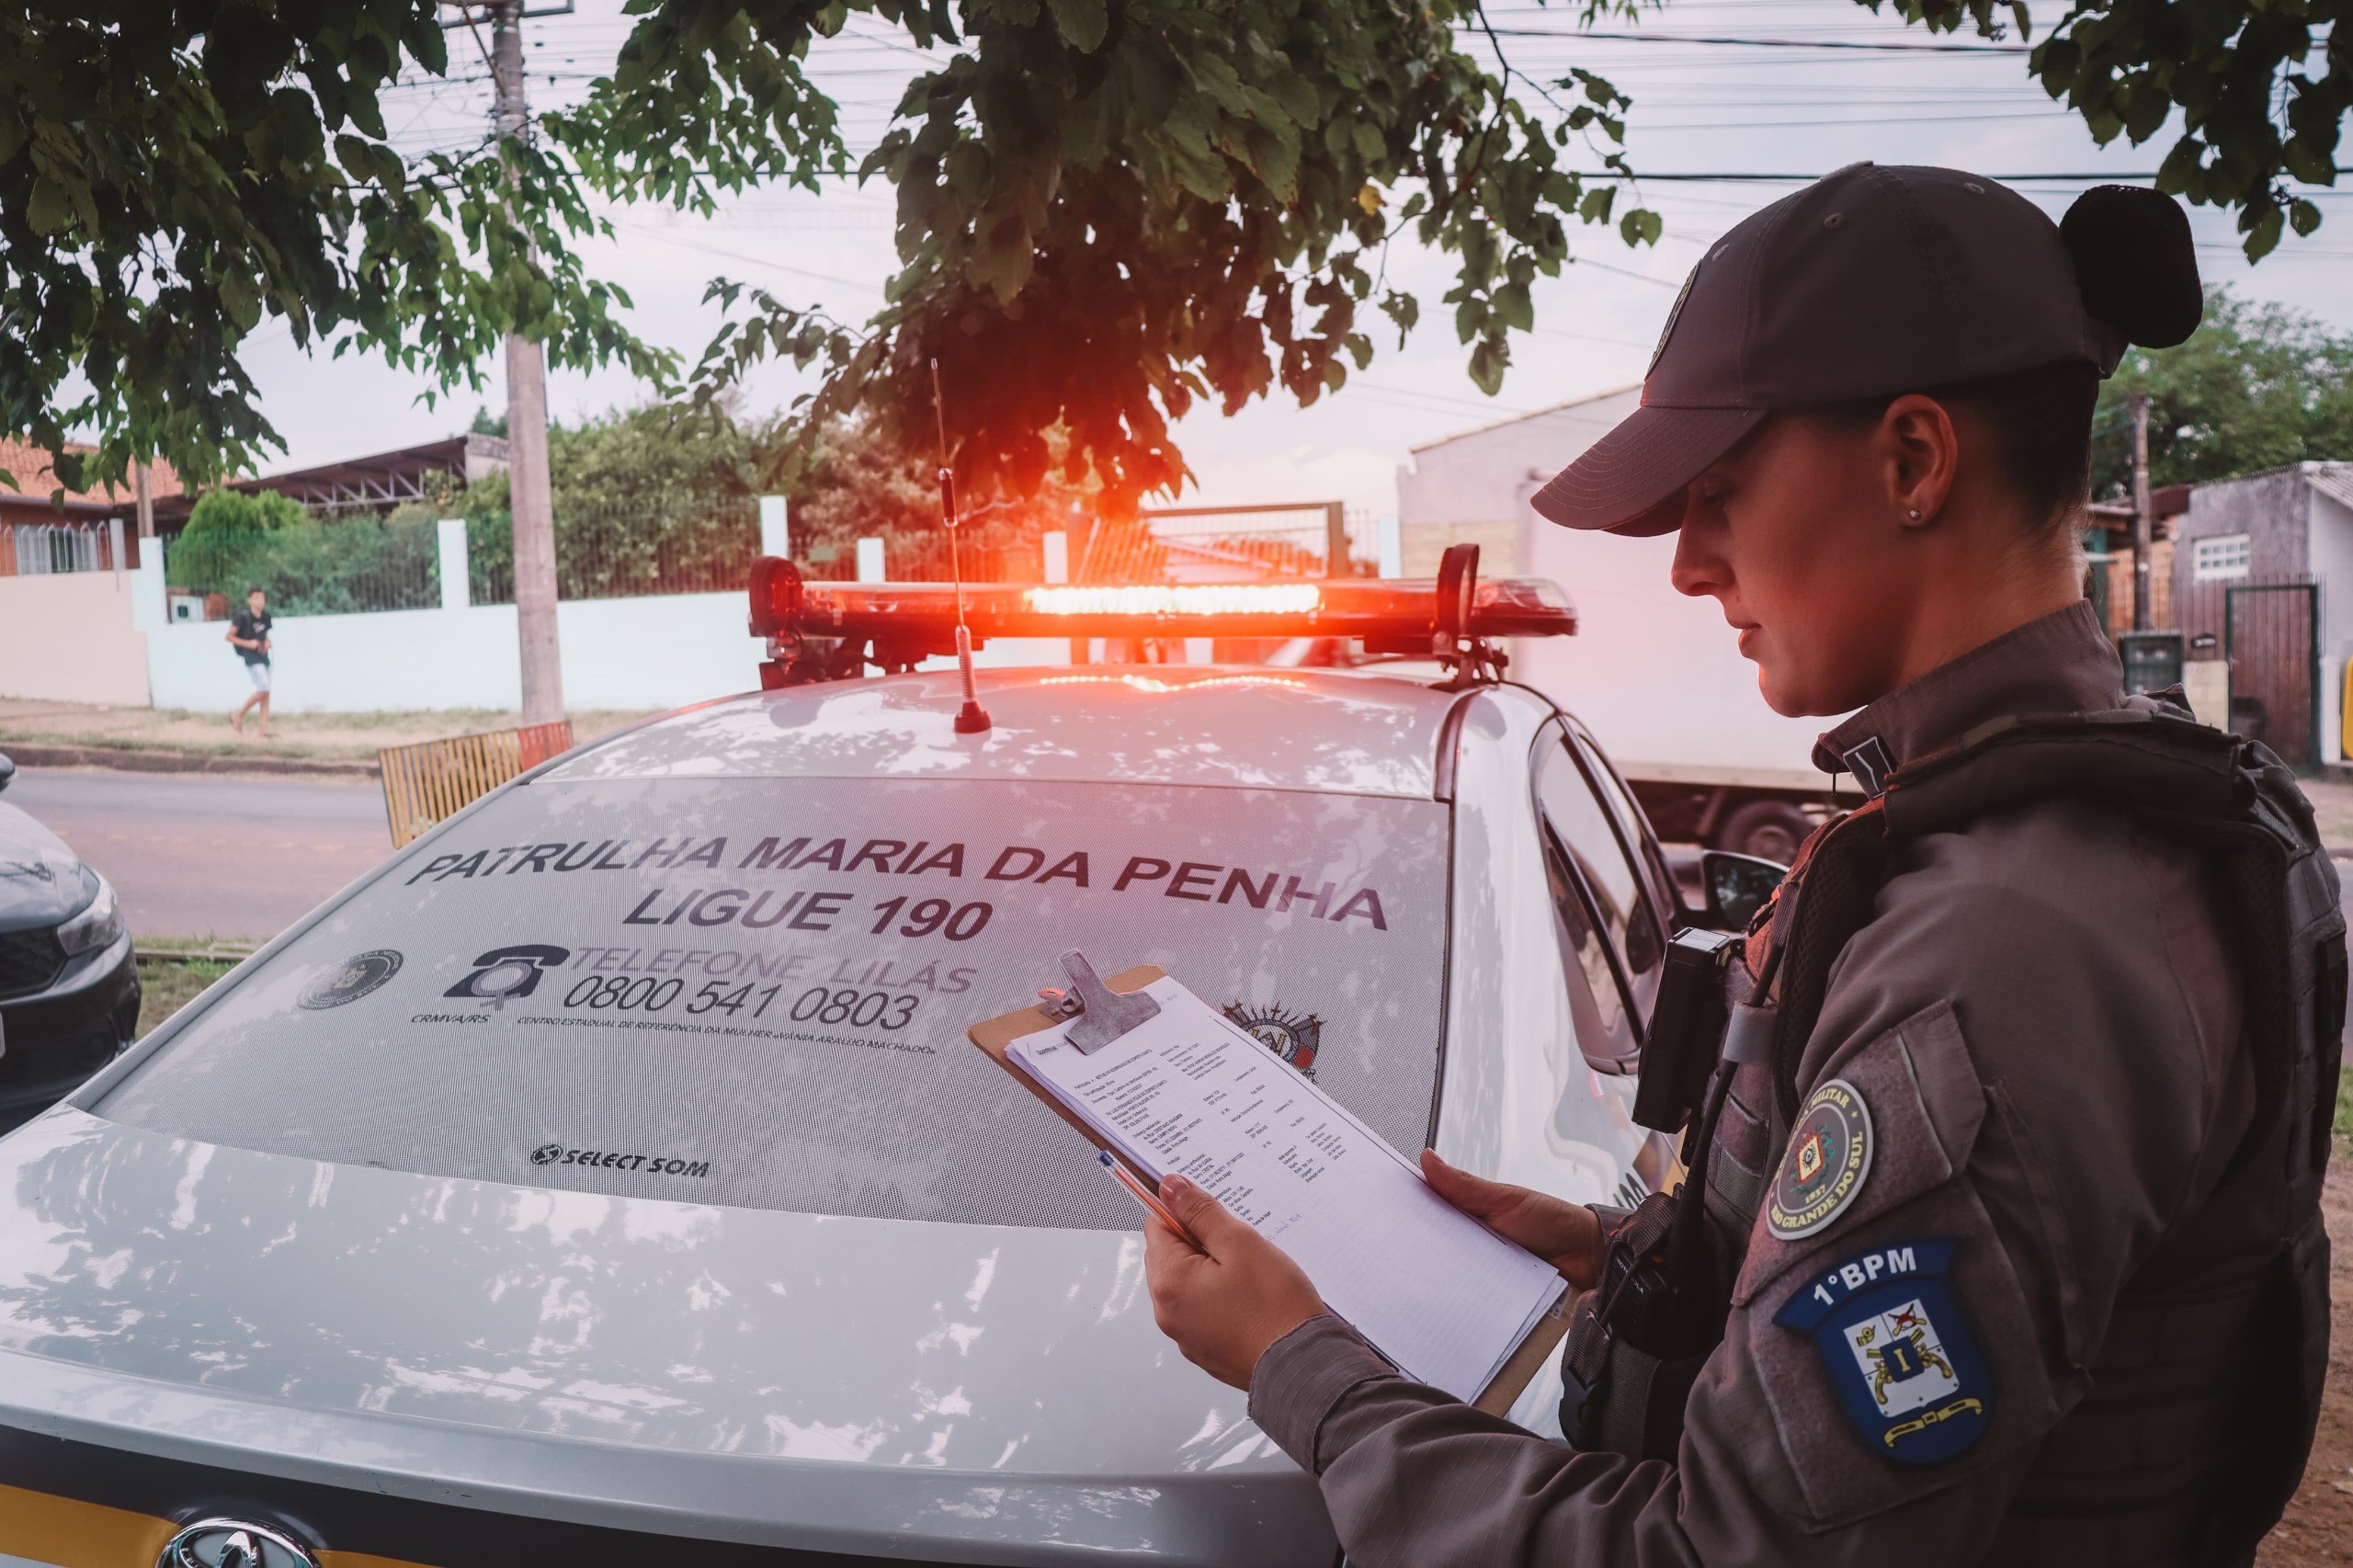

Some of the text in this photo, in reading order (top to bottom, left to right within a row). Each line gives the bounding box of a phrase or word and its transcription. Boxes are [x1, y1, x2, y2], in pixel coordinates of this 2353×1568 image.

[404, 836, 1388, 931] PATRULHA MARIA DA PENHA
[622, 889, 994, 941] LIGUE 190
[570, 947, 978, 994] TELEFONE LILÁS
[561, 1018, 615, 1028] ESTADUAL
[618, 1020, 633, 1028] DE
[563, 976, 920, 1031] 0800 541 0803
[1811, 1088, 1850, 1108] MILITAR
[561, 1150, 710, 1178] SELECT SOM
[1770, 1131, 1863, 1228] RIO GRANDE DO SUL
